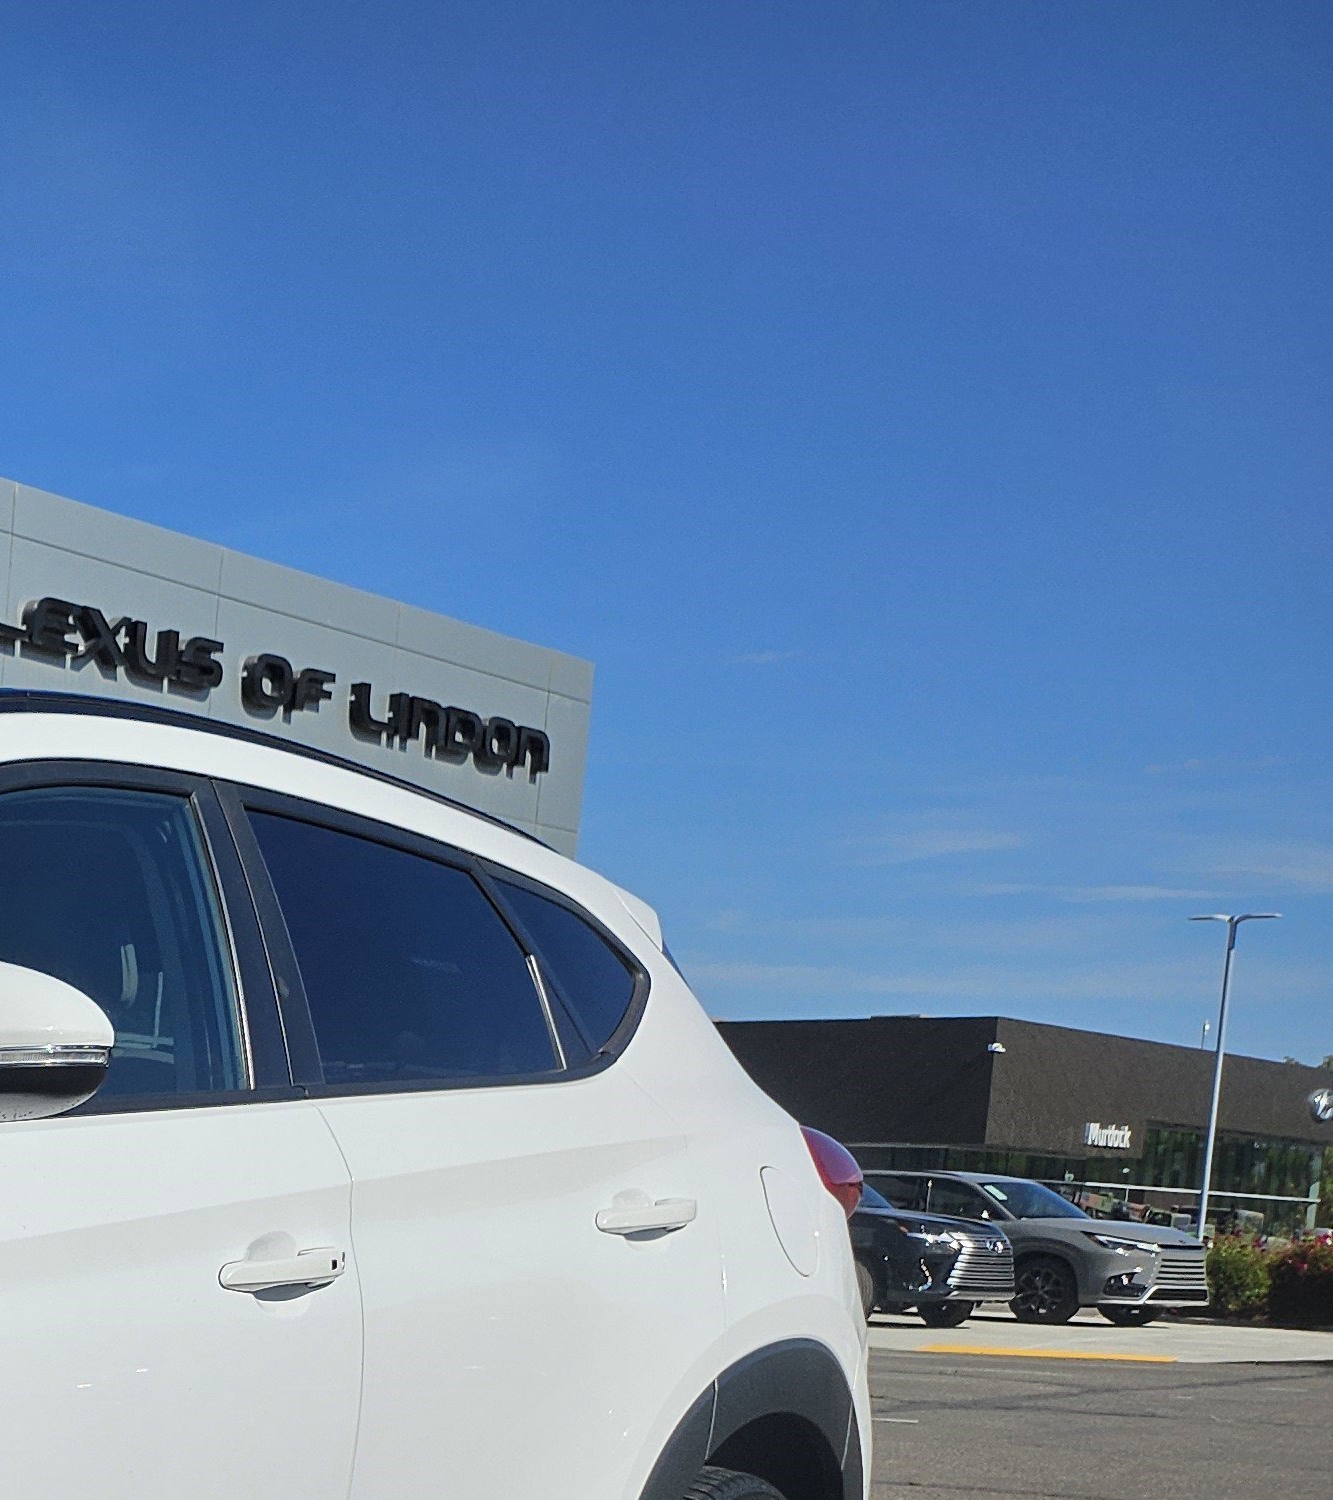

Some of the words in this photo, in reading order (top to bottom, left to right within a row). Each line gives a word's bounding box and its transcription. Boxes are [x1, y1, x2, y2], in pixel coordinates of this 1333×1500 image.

[241, 653, 335, 724] OF
[349, 681, 551, 783] LINDON
[1085, 1122, 1132, 1149] Murdock
